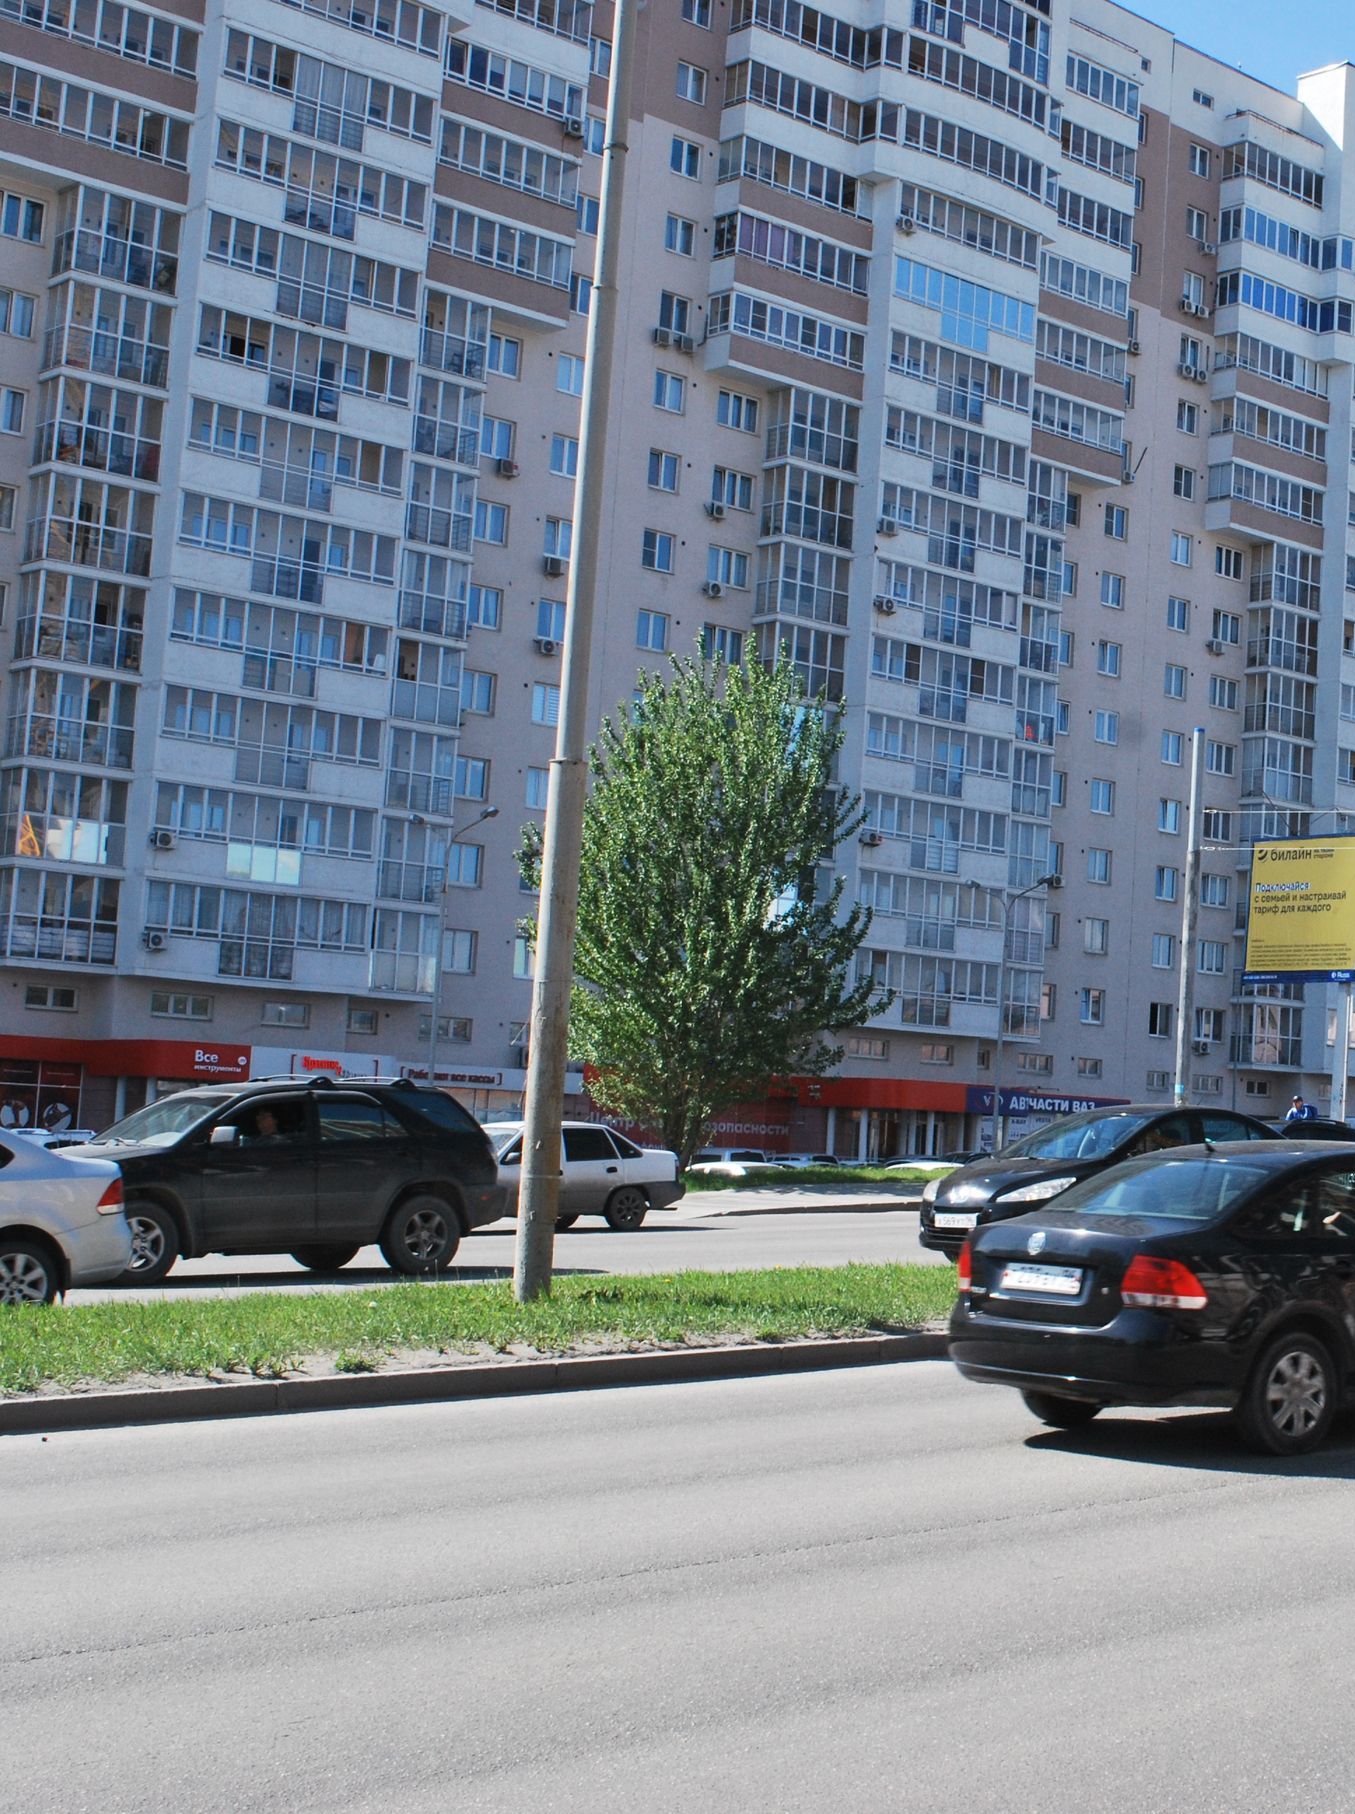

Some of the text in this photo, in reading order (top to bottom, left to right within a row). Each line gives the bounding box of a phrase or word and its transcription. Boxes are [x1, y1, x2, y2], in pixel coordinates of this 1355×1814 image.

[1270, 848, 1312, 861] билайн
[1256, 881, 1310, 893] Подключайся
[1254, 895, 1260, 903] с
[1292, 894, 1298, 902] и
[1299, 890, 1346, 903] настраивай
[1254, 903, 1331, 914] тариф для каждого
[194, 1049, 219, 1063] Все
[194, 1064, 242, 1073] инструменты
[468, 1075, 495, 1084] кассы
